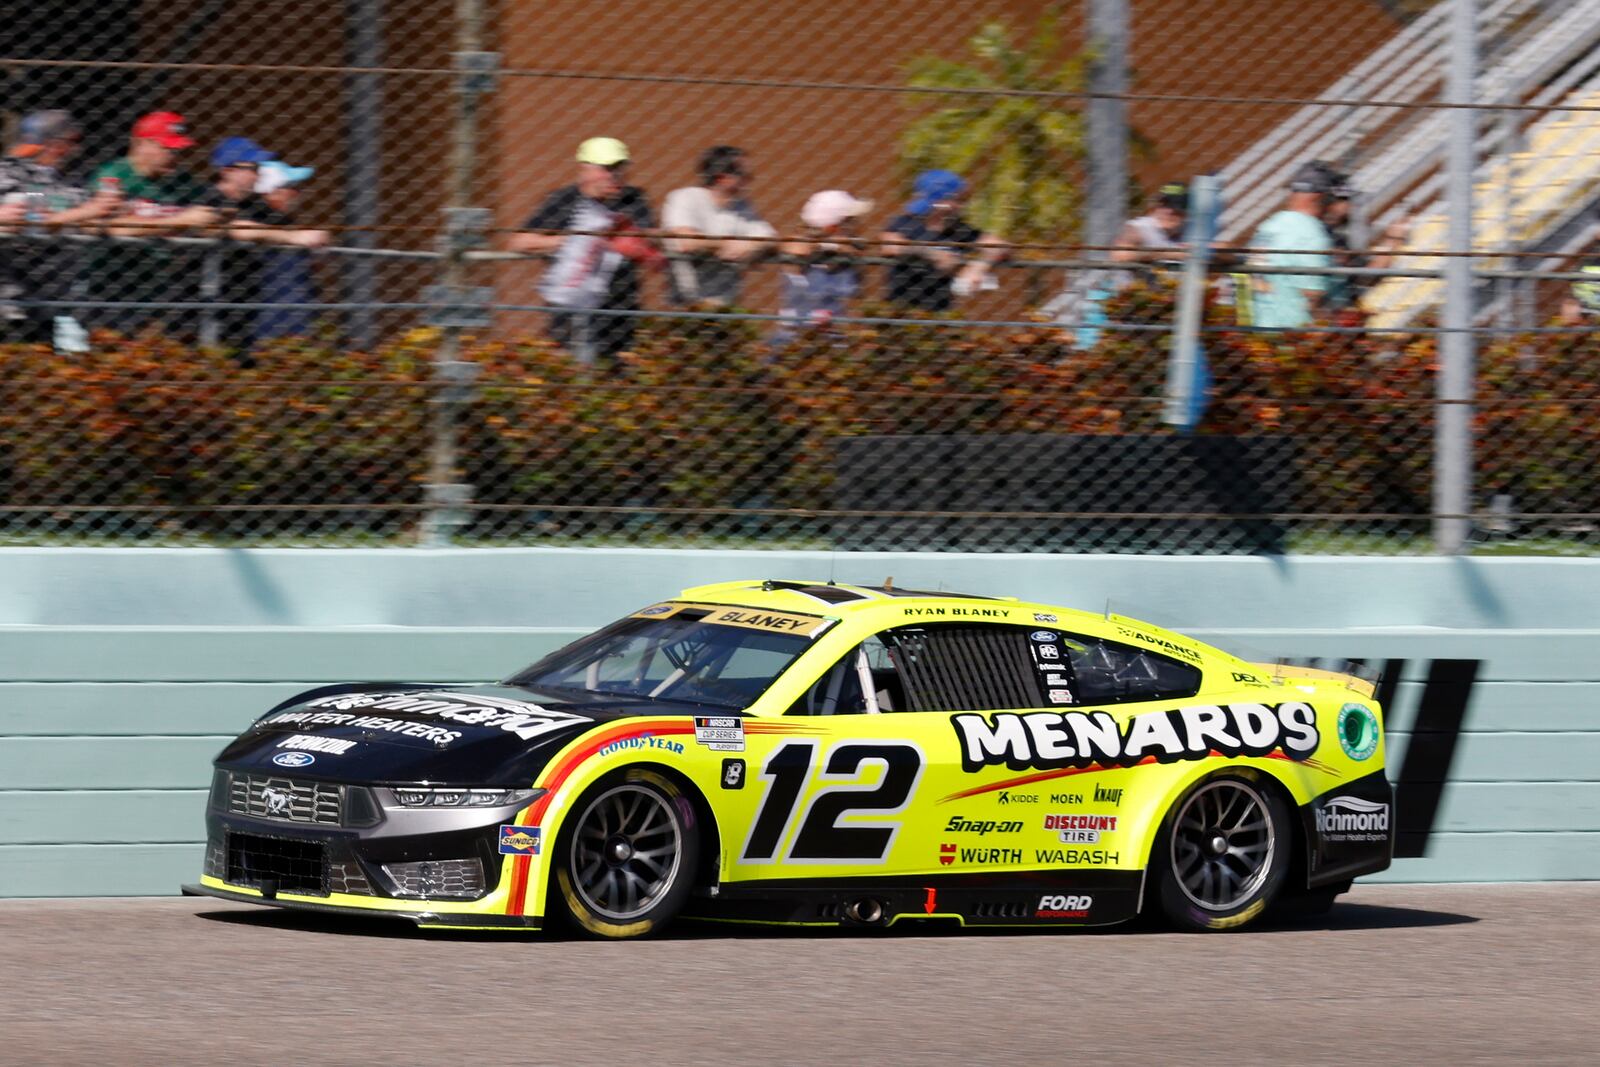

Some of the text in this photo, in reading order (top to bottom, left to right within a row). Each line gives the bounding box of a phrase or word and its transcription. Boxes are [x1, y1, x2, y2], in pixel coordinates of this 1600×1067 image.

[904, 608, 1010, 617] RYAN BLANEY
[718, 611, 809, 631] BLANEY
[1136, 632, 1202, 660] ADVANCE
[268, 712, 463, 744] WATER HEATERS
[709, 718, 736, 728] NASCAR
[703, 730, 737, 739] CUP SERIES
[951, 702, 1320, 771] MENARDS
[276, 753, 312, 766] Ford
[739, 740, 925, 863] 12
[1010, 794, 1039, 804] KIDDE
[1050, 793, 1083, 805] MOEN
[1044, 814, 1118, 831] DISCOUNT
[1315, 803, 1389, 832] Richmond
[944, 815, 1024, 836] Snap-on
[503, 836, 538, 846] SUNOCO
[1063, 831, 1095, 842] TIRE
[960, 848, 1022, 865] WÜRTH
[1035, 850, 1119, 865] WABASH
[1038, 895, 1092, 910] FORD
[1034, 910, 1089, 918] PERFORMANCE
